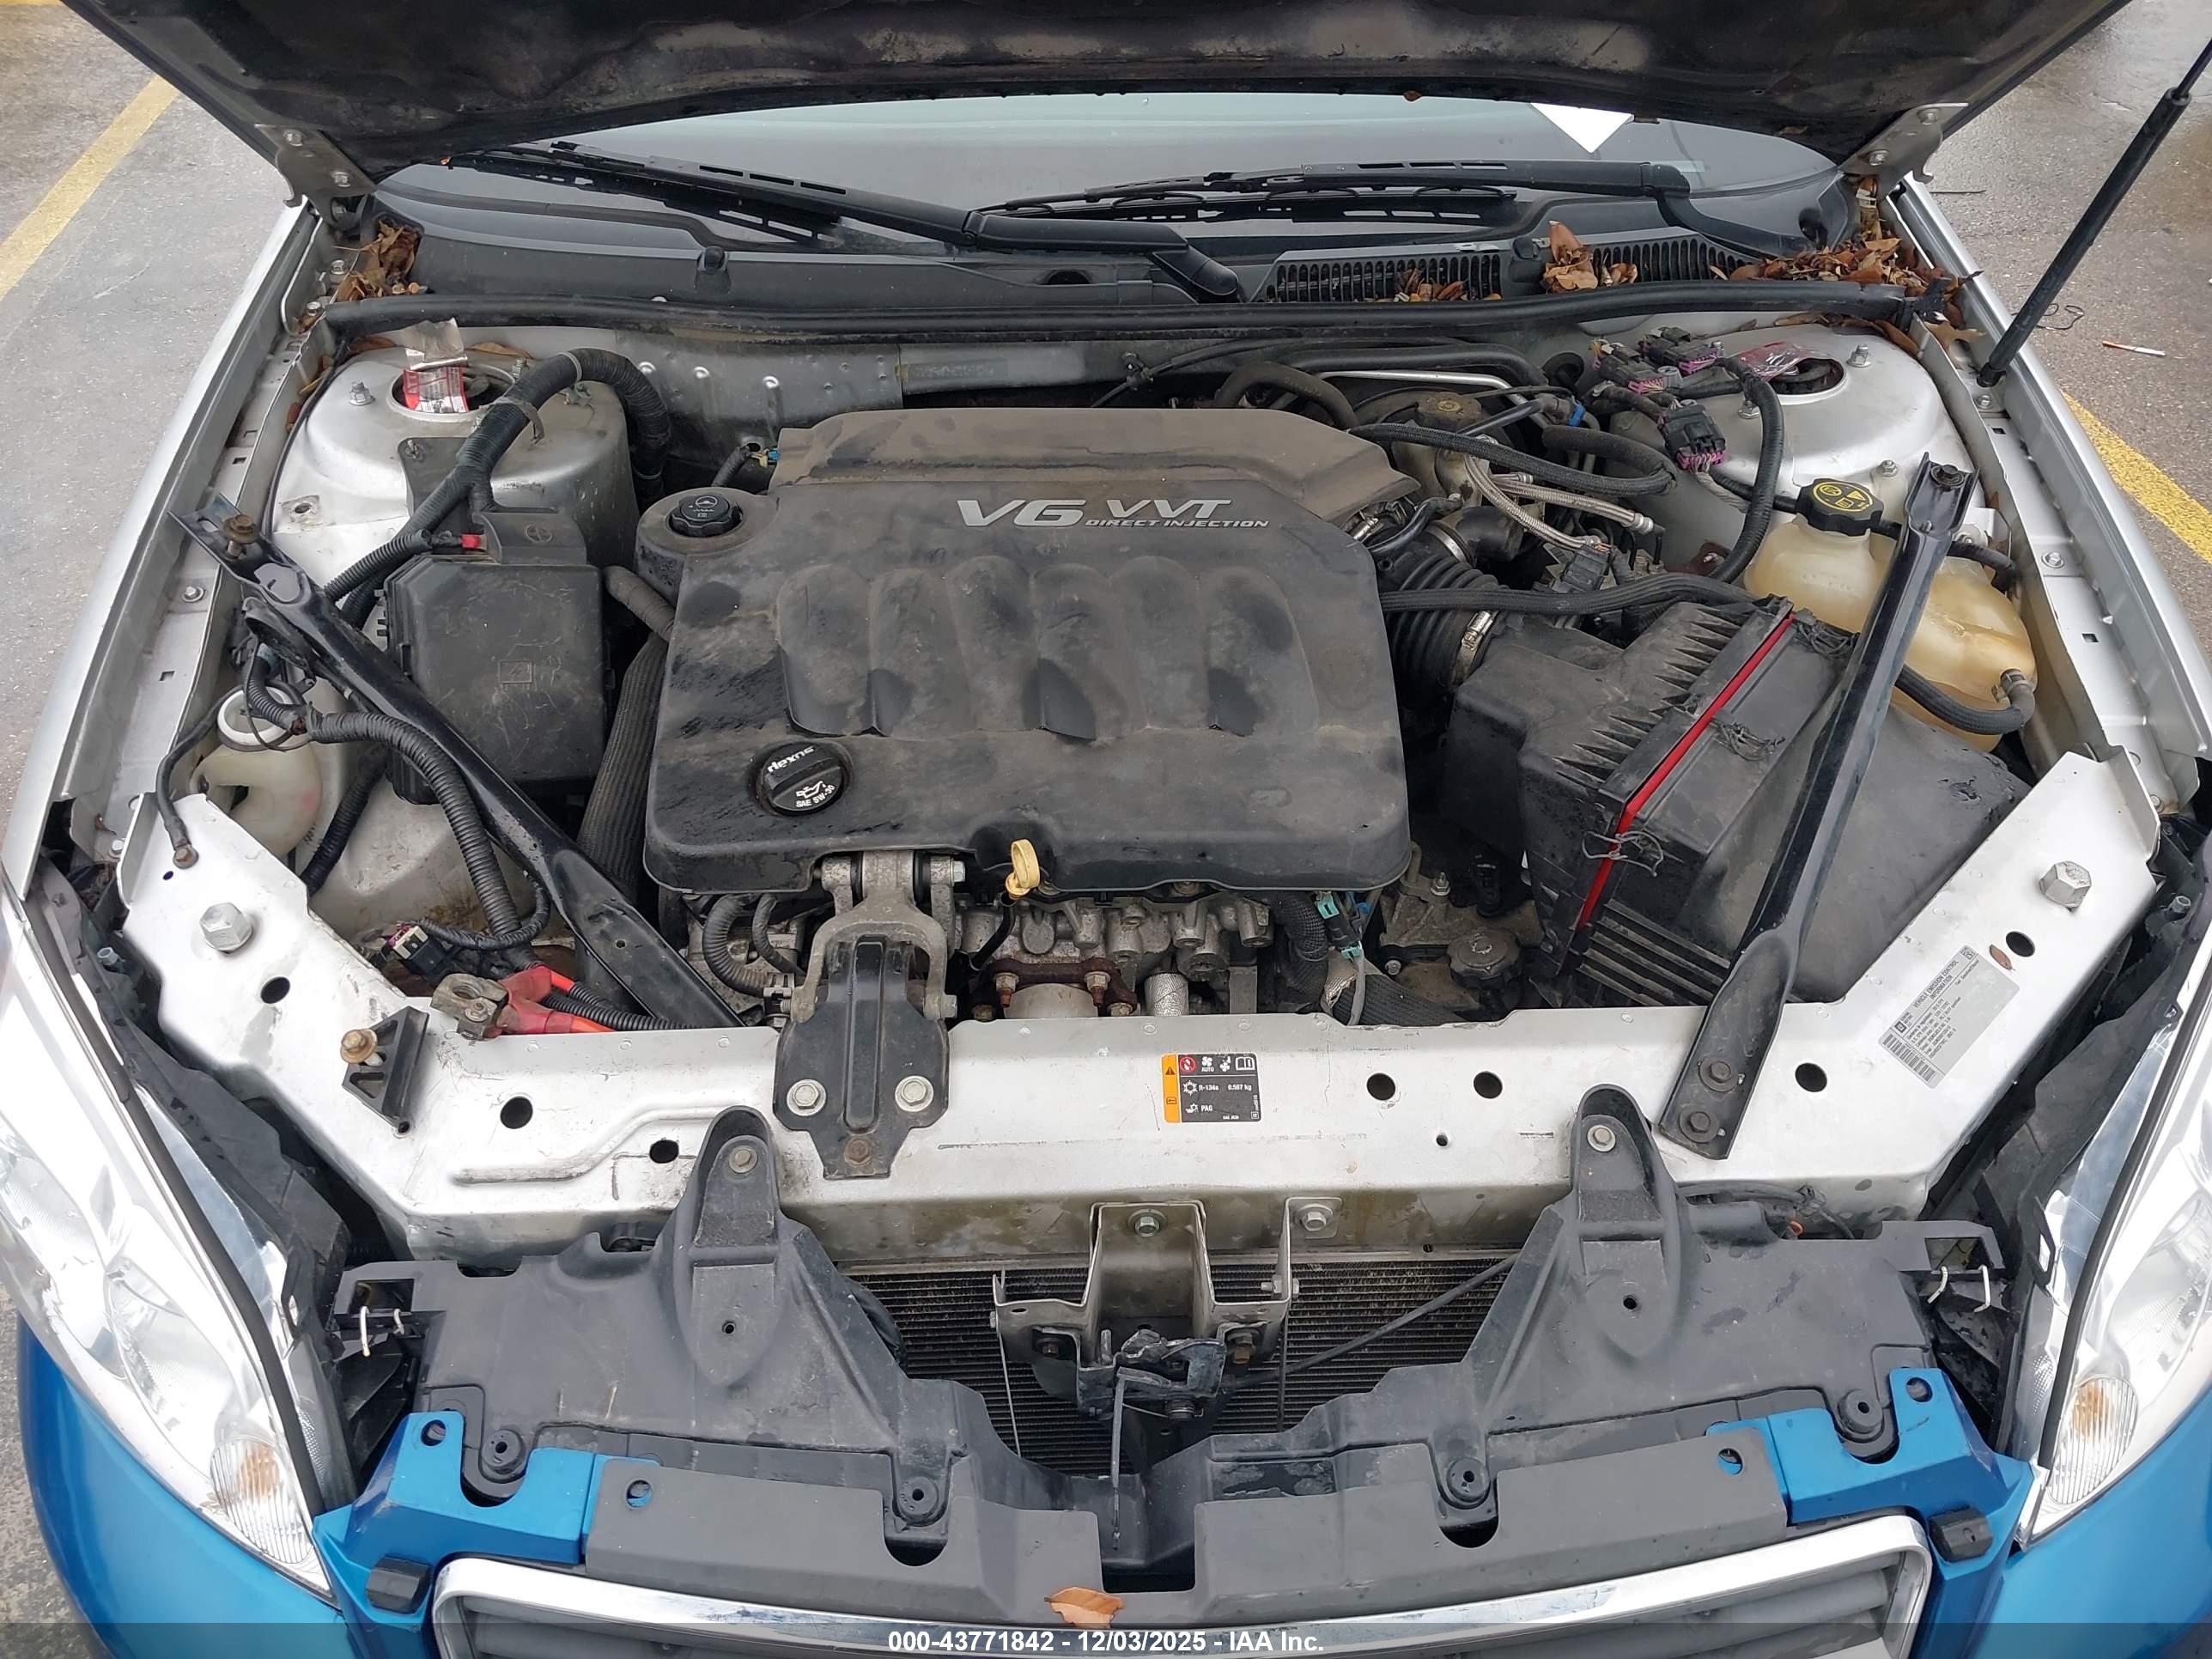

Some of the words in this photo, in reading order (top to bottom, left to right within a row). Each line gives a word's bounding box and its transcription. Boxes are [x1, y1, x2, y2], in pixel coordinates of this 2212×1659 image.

[957, 500, 1086, 526] V6
[1106, 500, 1231, 518] VVT
[1164, 520, 1270, 528] INJECTION
[795, 799, 811, 808] SAE
[812, 785, 835, 804] 5W-30
[1244, 1084, 1252, 1092] kg
